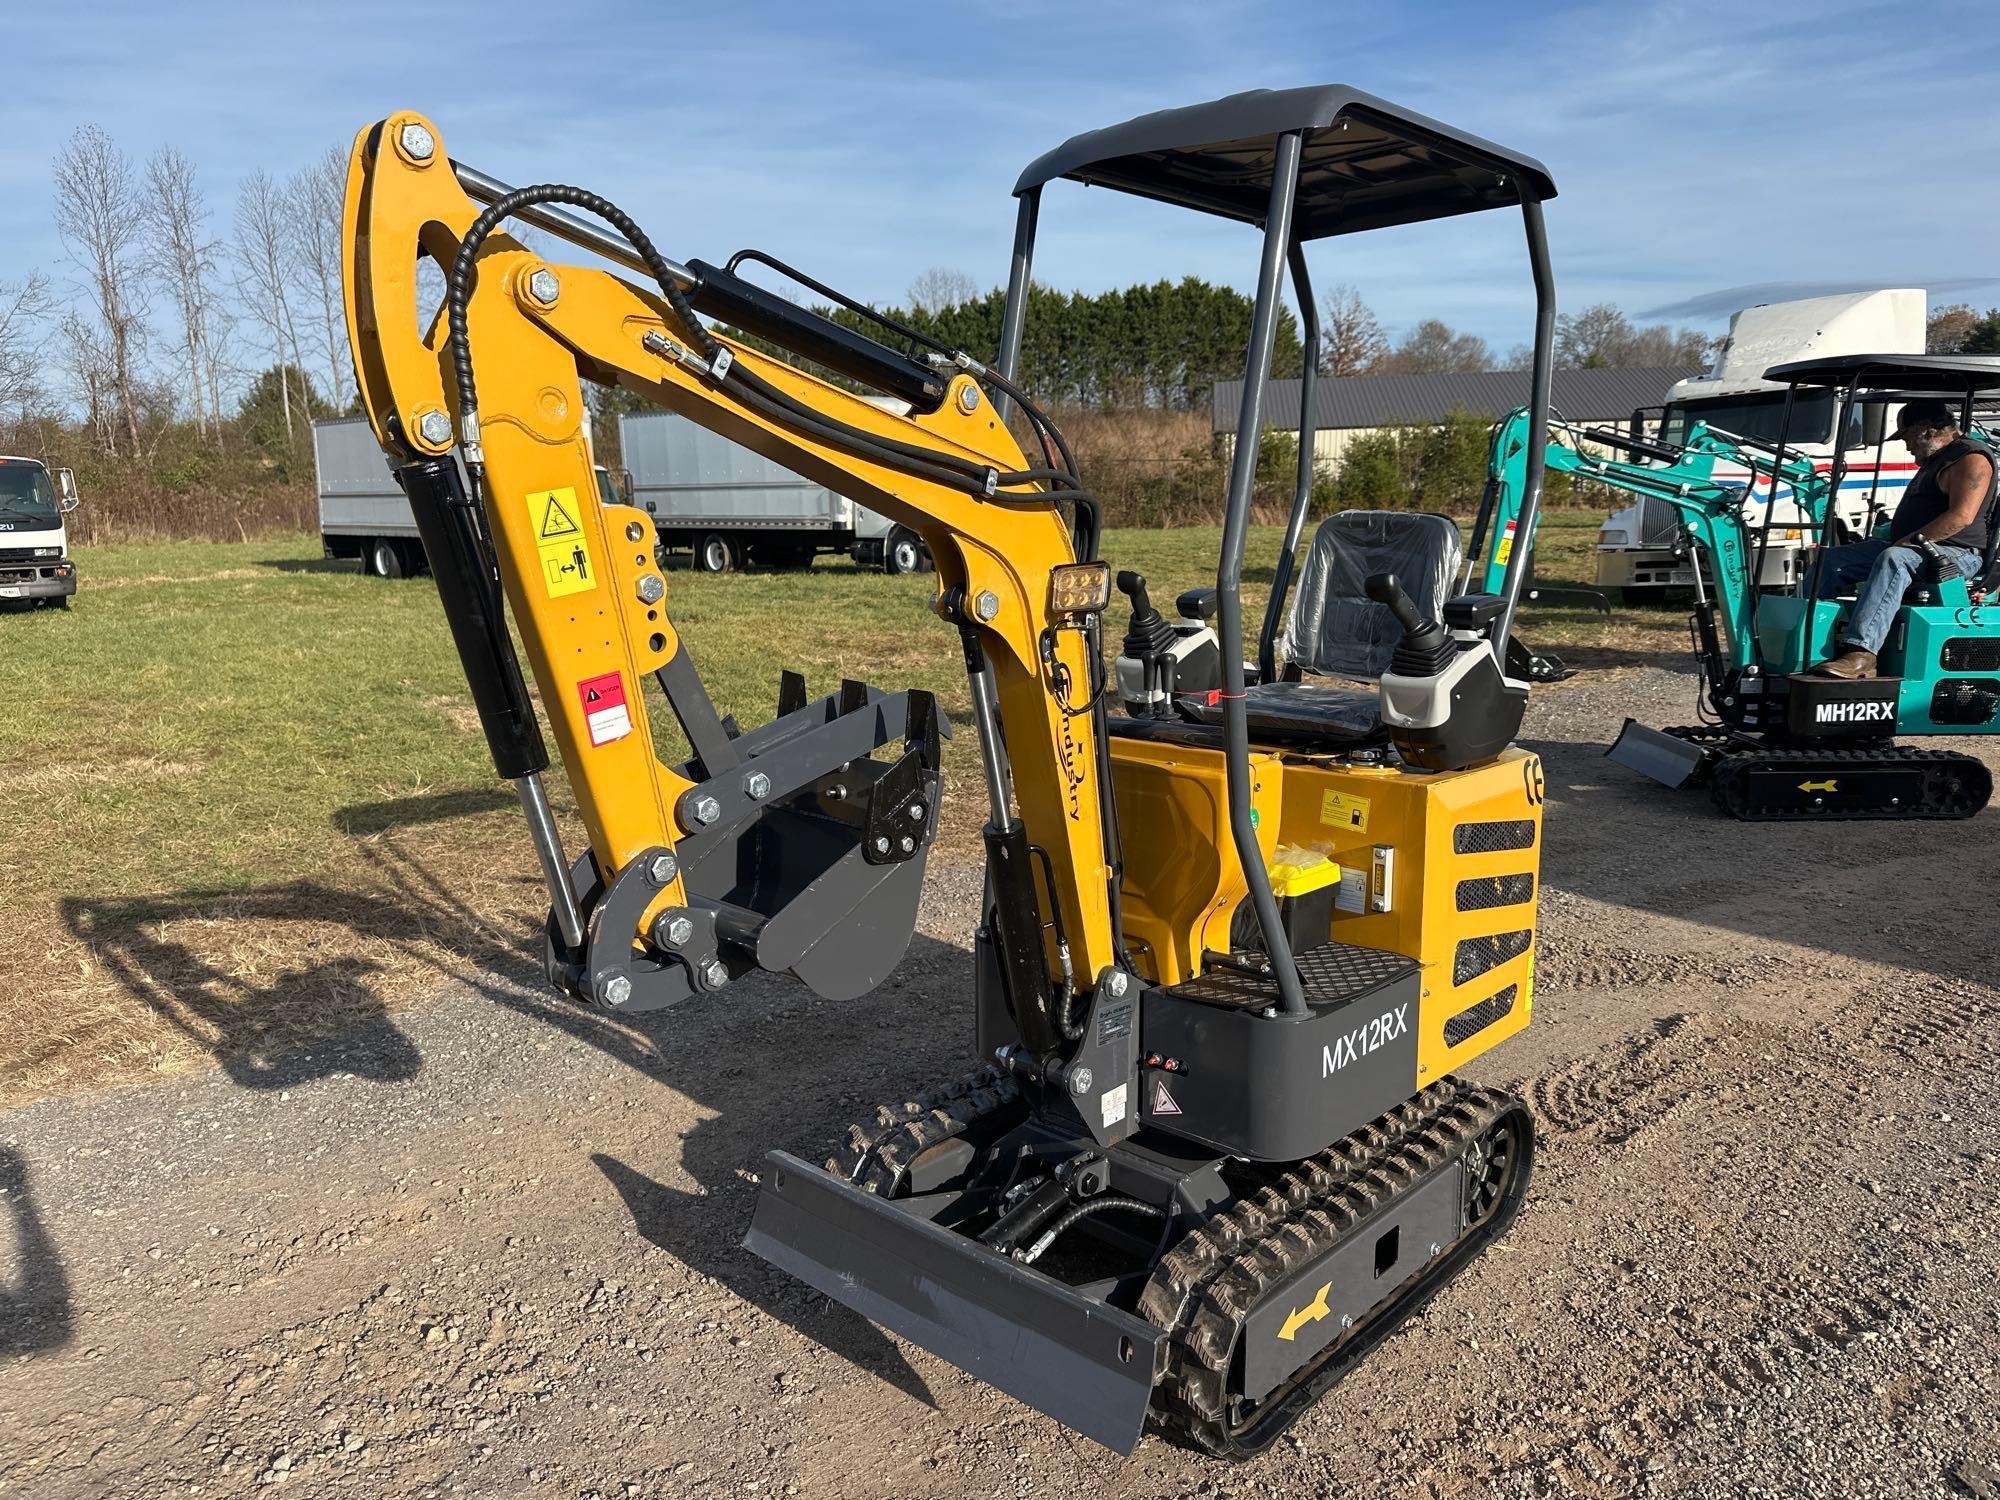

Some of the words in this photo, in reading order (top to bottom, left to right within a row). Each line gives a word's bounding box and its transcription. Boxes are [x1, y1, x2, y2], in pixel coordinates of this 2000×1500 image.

[1954, 607, 1985, 629] CE
[1816, 701, 1895, 722] MH12RX
[1524, 758, 1542, 806] CE
[1323, 1003, 1408, 1078] MX12RX
